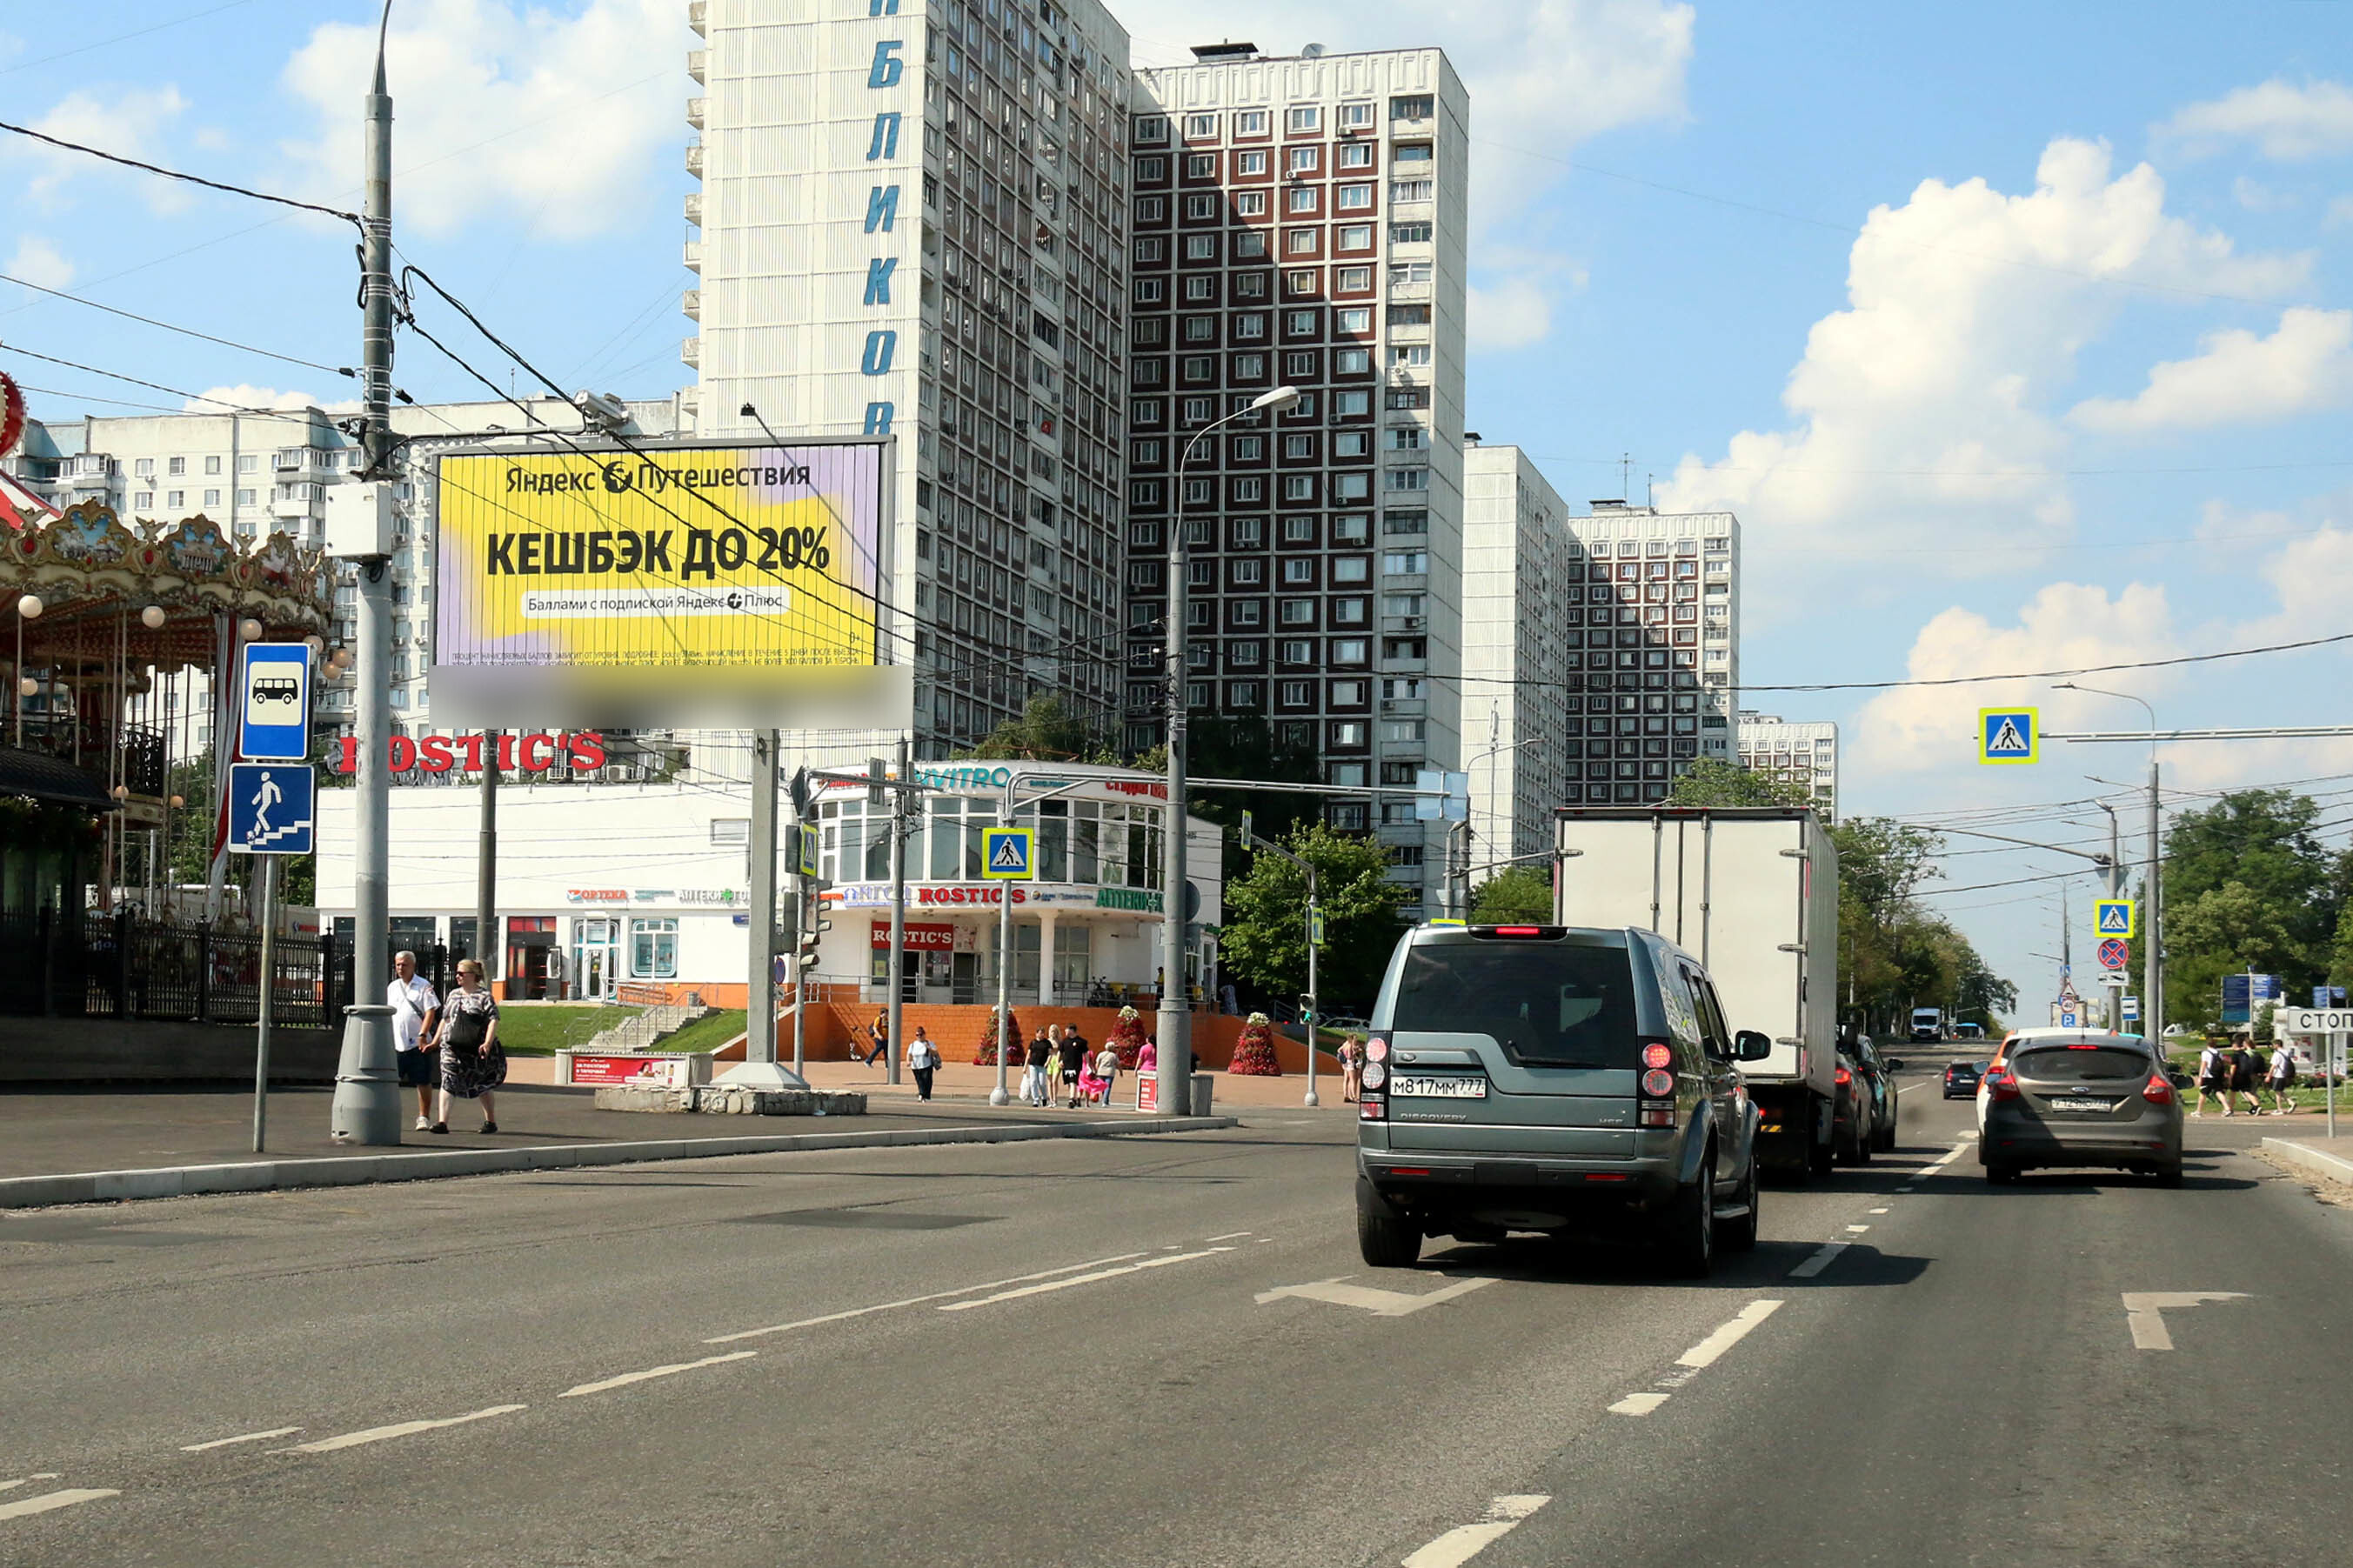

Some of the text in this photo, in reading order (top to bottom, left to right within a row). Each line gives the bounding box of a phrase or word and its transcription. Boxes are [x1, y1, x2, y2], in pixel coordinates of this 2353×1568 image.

[506, 464, 810, 496] Яндекс Путешествия
[487, 525, 830, 581] КЕШБЭК ДО 20%
[528, 594, 783, 611] Баллами с подпиской Яндекс Плюс
[919, 887, 1026, 904] ROSTICS
